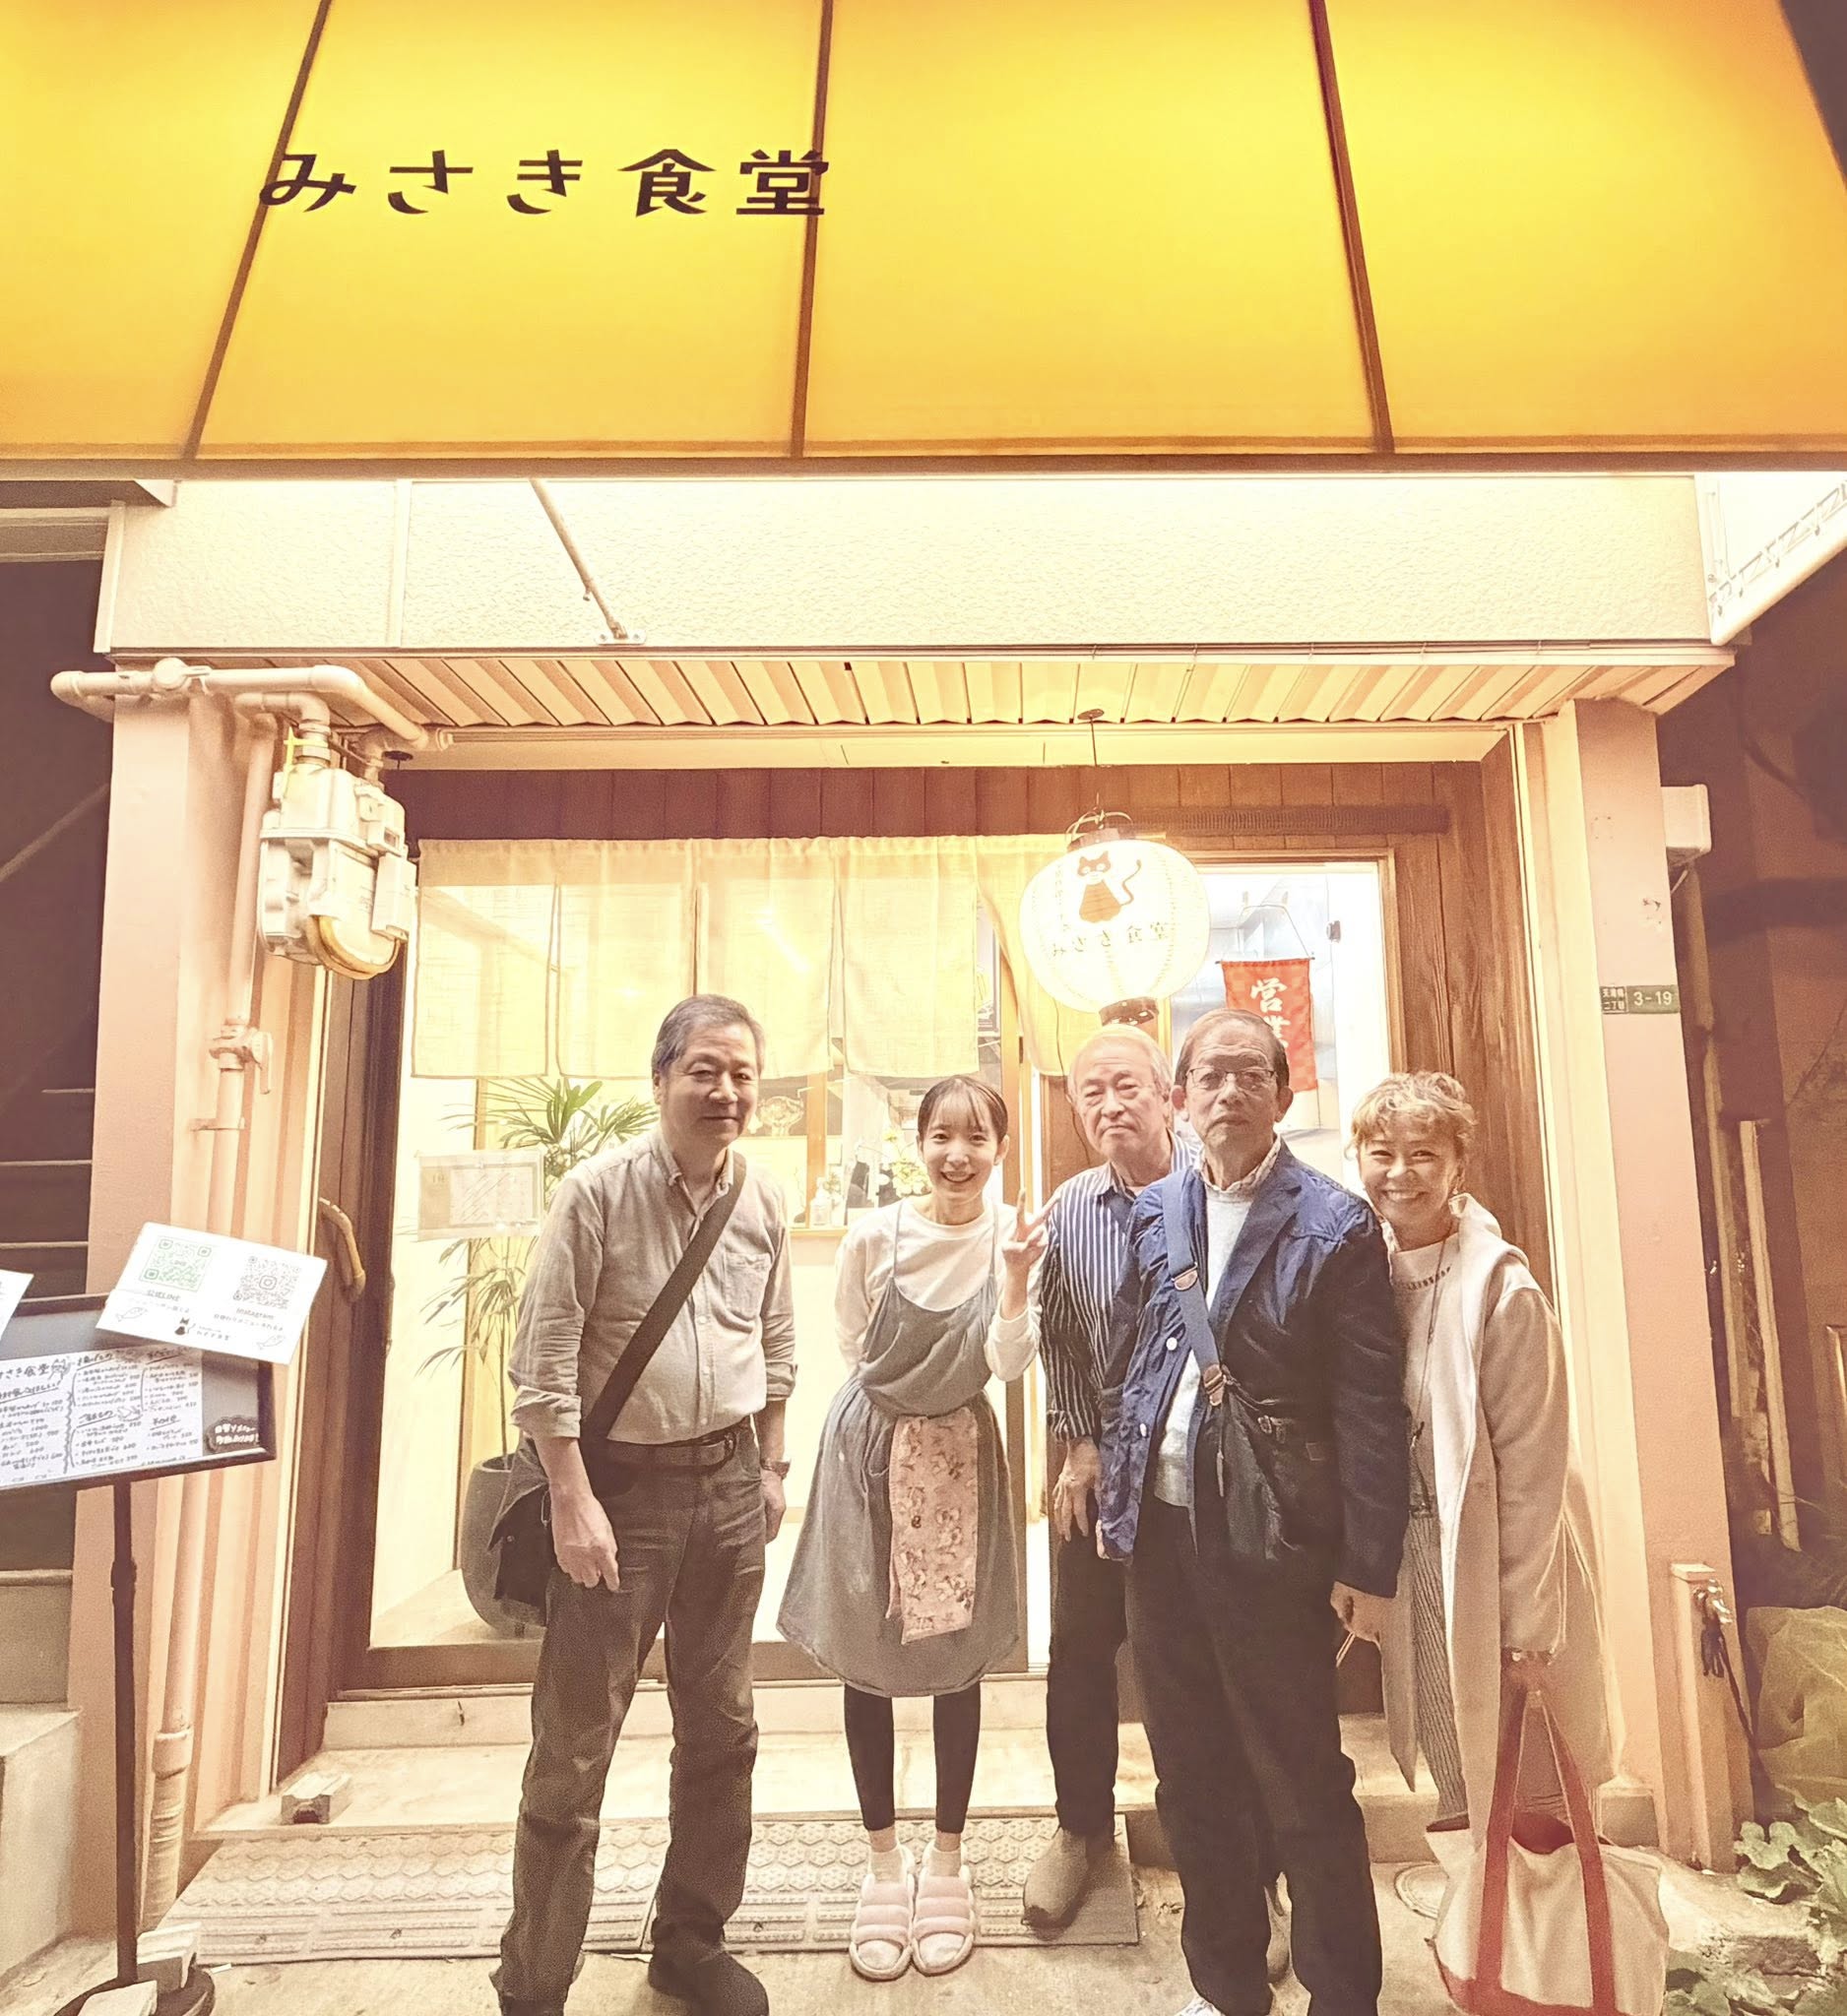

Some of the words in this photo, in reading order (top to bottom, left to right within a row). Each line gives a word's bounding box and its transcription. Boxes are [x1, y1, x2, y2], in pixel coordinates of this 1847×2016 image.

[259, 149, 830, 218] みさき食堂
[1632, 990, 1673, 1006] 3-19
